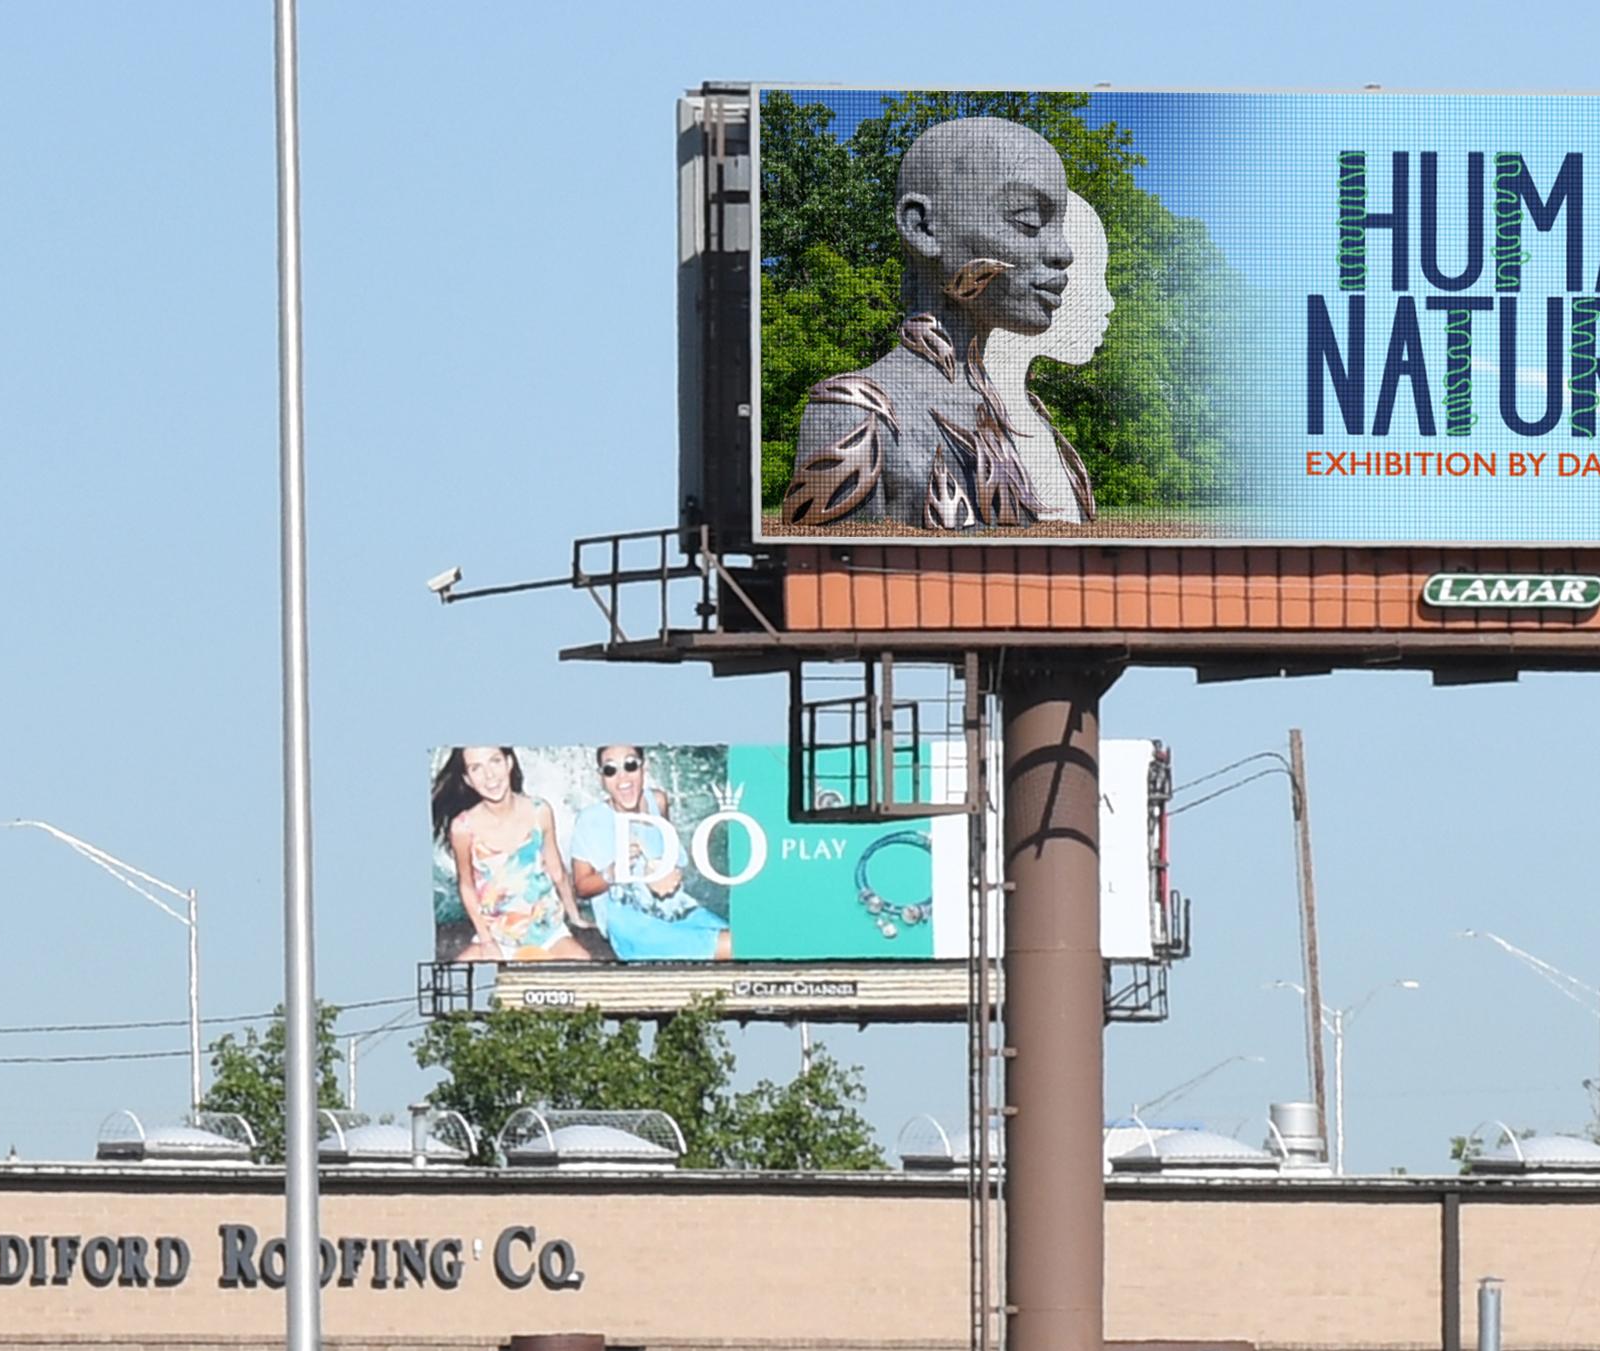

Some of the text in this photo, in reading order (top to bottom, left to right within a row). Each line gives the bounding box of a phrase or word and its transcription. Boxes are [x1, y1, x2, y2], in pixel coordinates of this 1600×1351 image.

[1306, 451, 1497, 477] EXHIBITION
[1509, 452, 1547, 477] BY
[1438, 579, 1588, 602] LAMAR
[782, 838, 847, 860] PLAY
